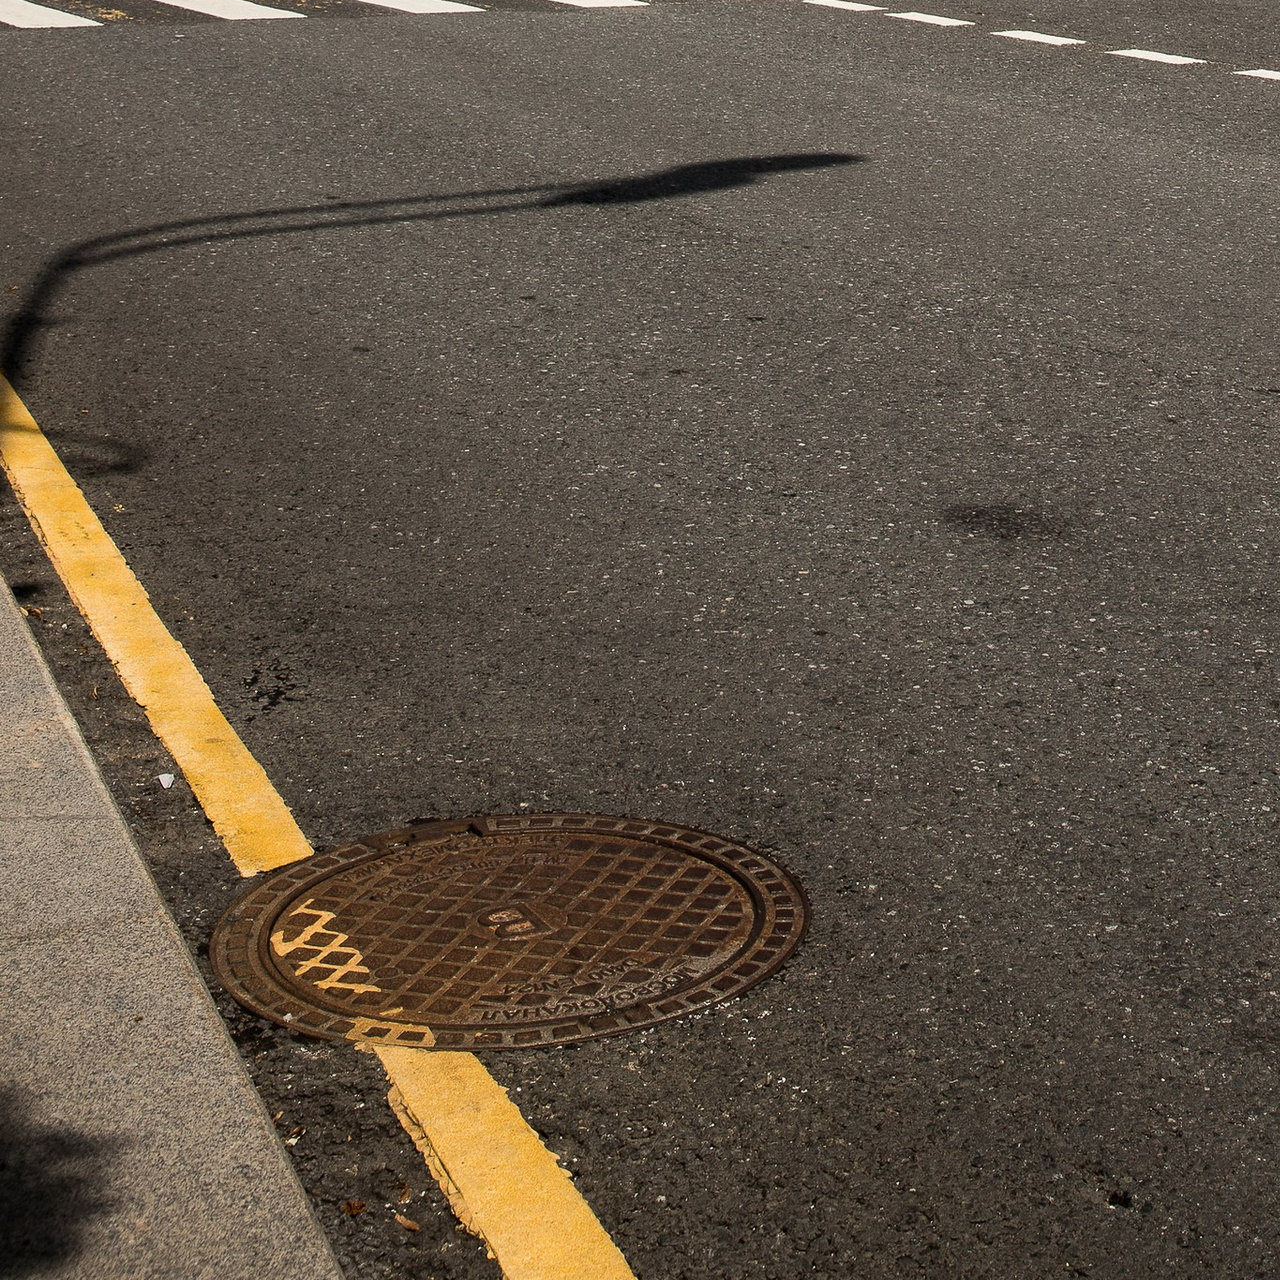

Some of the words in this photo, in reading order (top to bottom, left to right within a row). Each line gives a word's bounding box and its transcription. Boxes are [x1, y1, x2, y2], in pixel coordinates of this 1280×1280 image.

[586, 958, 643, 981] D400
[481, 966, 700, 1022] МОСВОДОКАНАЛ
[503, 977, 576, 994] EN124
